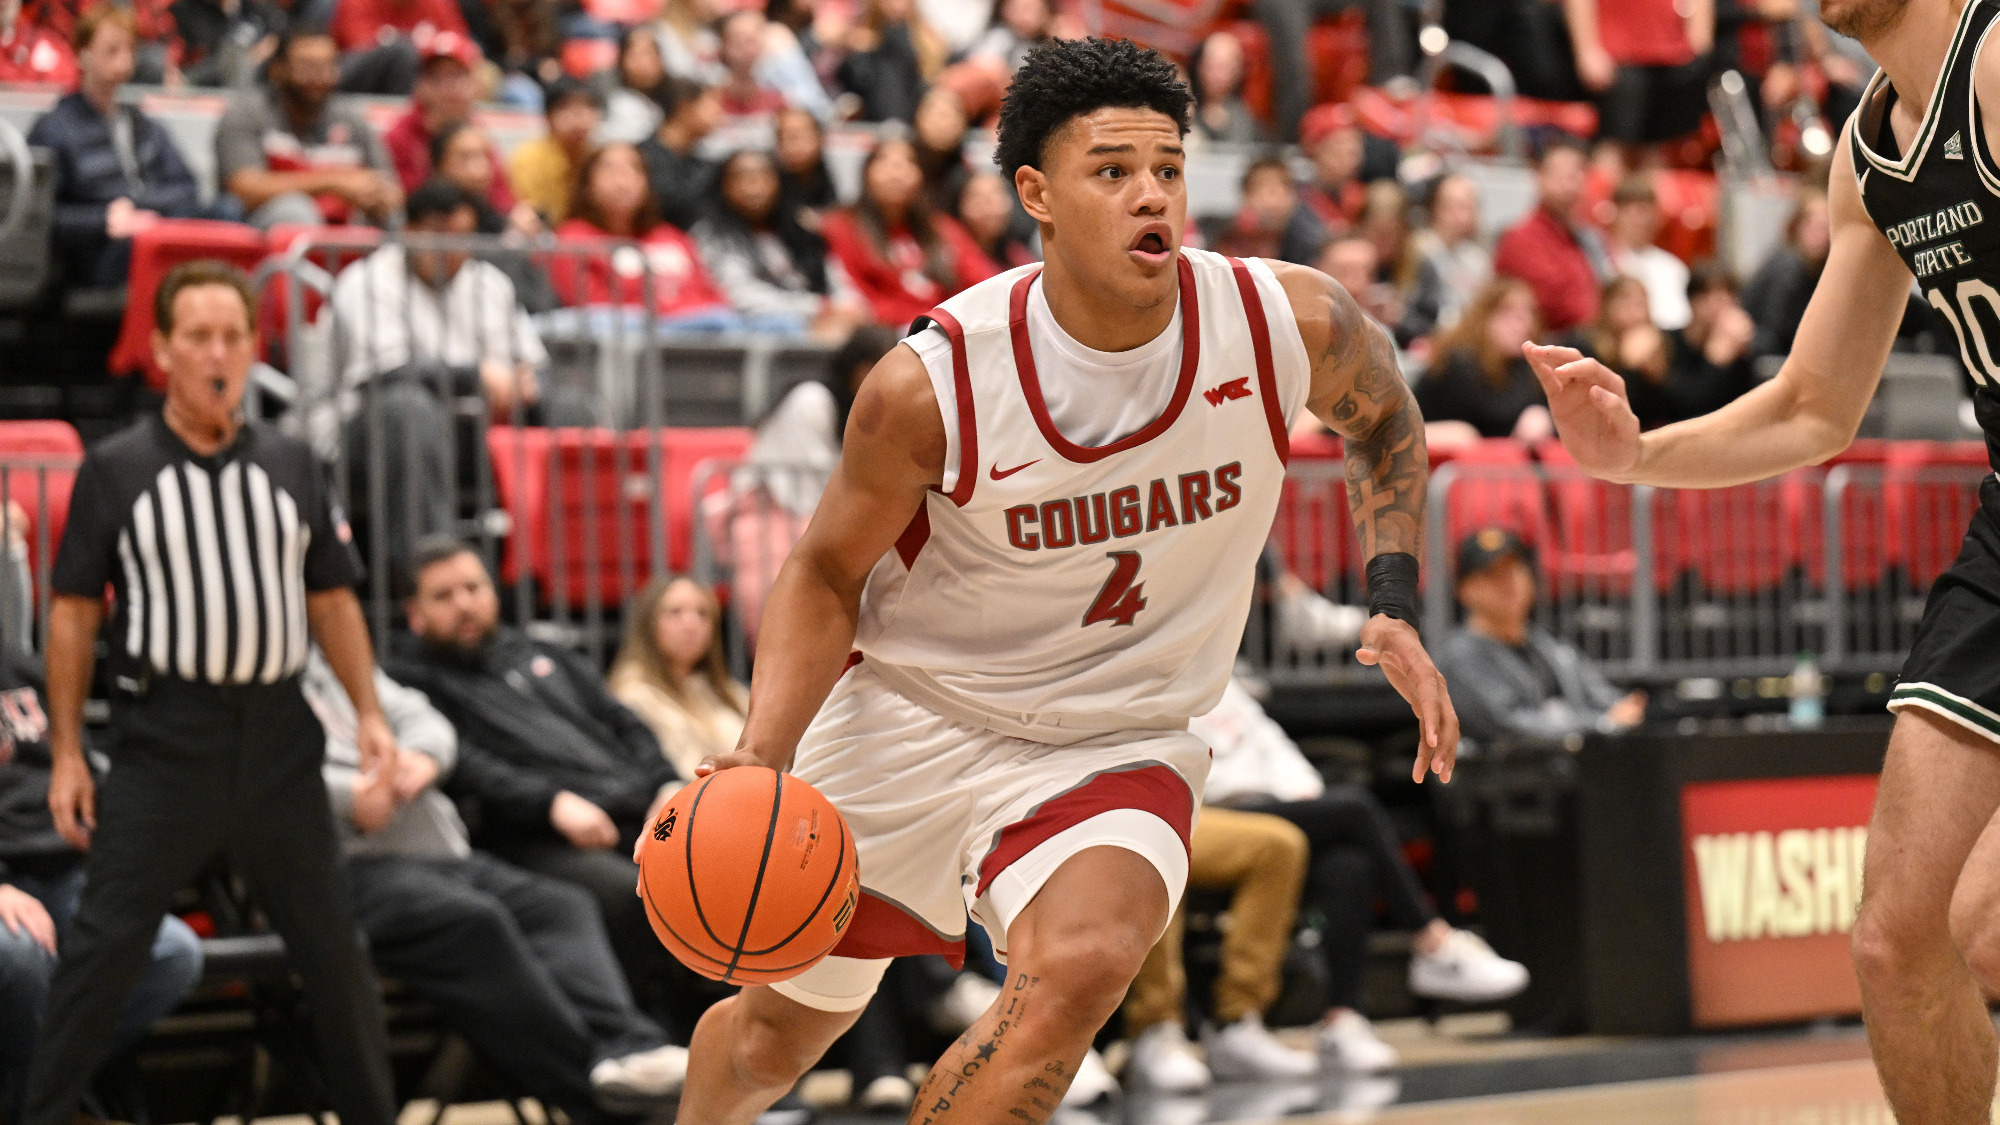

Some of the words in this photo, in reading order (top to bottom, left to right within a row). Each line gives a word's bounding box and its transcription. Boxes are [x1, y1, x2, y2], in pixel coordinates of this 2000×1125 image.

[1886, 199, 1984, 249] PORTLAND
[1914, 240, 1973, 278] STATE
[1003, 461, 1242, 551] COUGARS
[1081, 550, 1149, 628] 4
